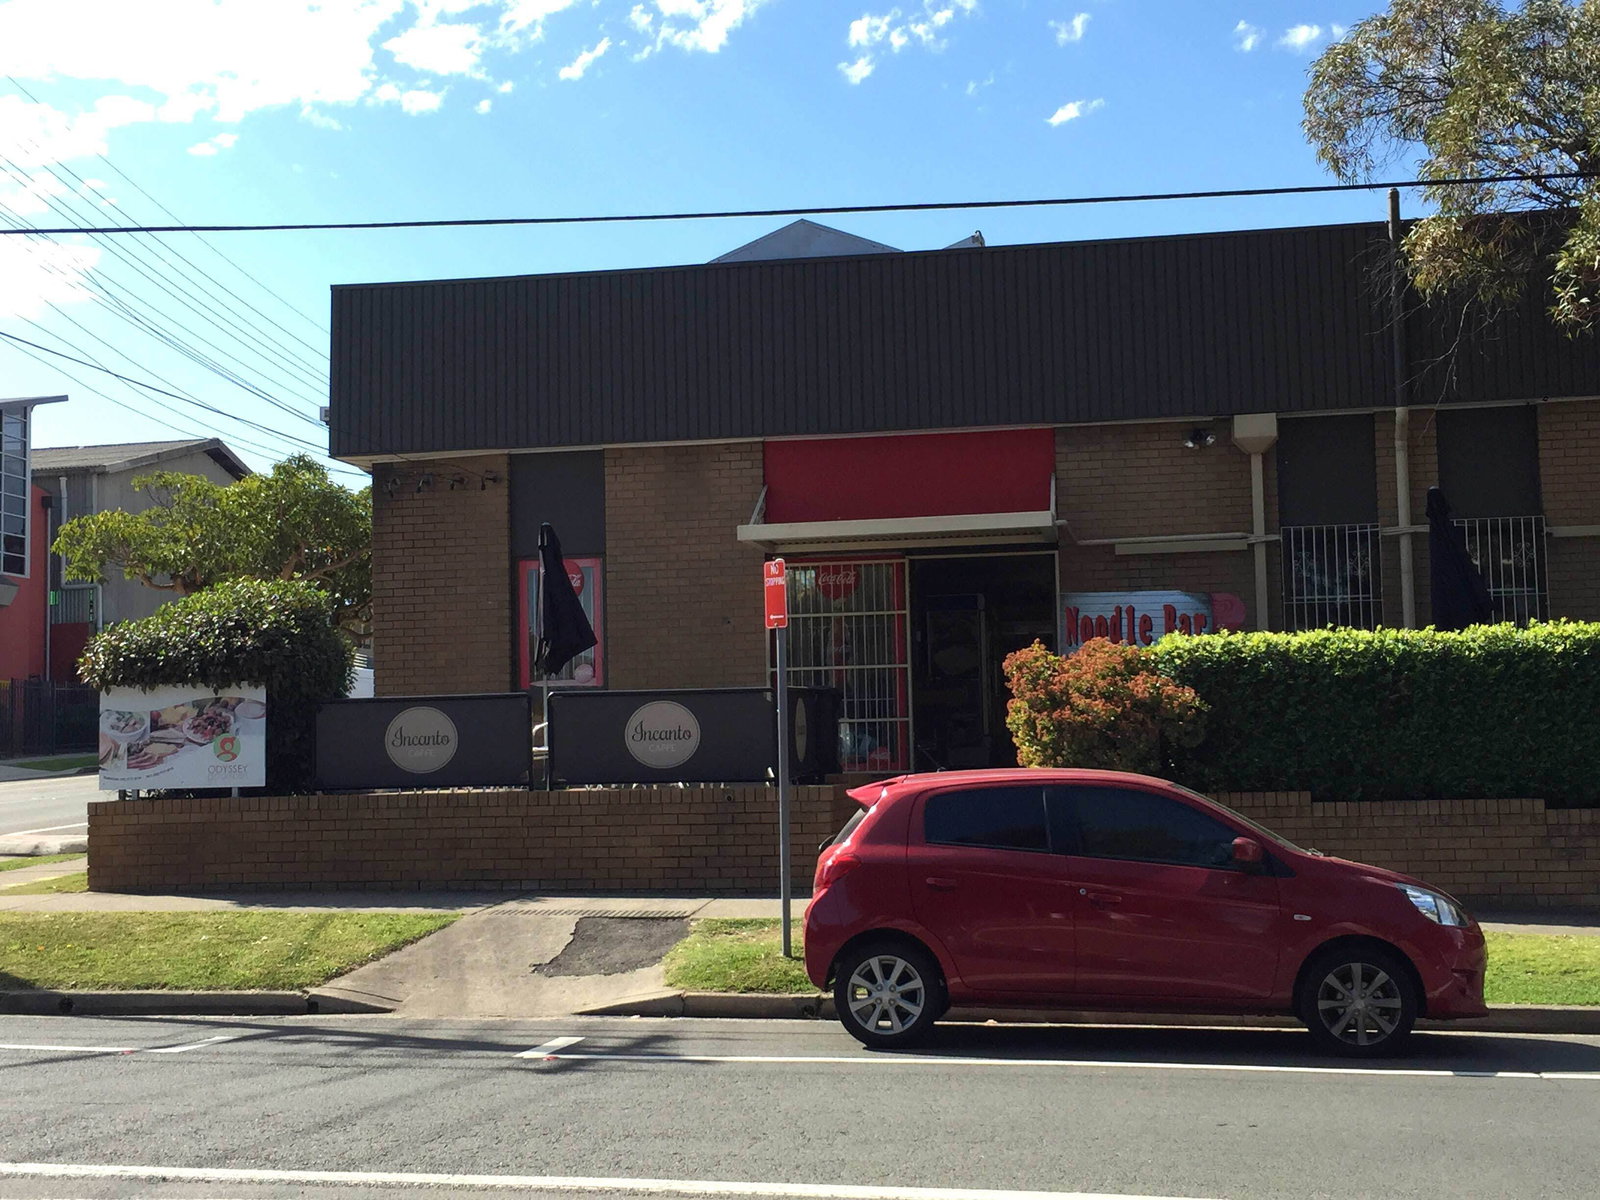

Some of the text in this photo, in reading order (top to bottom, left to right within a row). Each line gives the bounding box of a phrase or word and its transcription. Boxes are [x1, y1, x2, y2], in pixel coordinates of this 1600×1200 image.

[770, 563, 779, 575] NO
[1065, 604, 1207, 646] Noodle Bar
[391, 725, 450, 748] Incanto
[631, 720, 692, 742] Incanto
[207, 764, 248, 774] ODYSSEY
